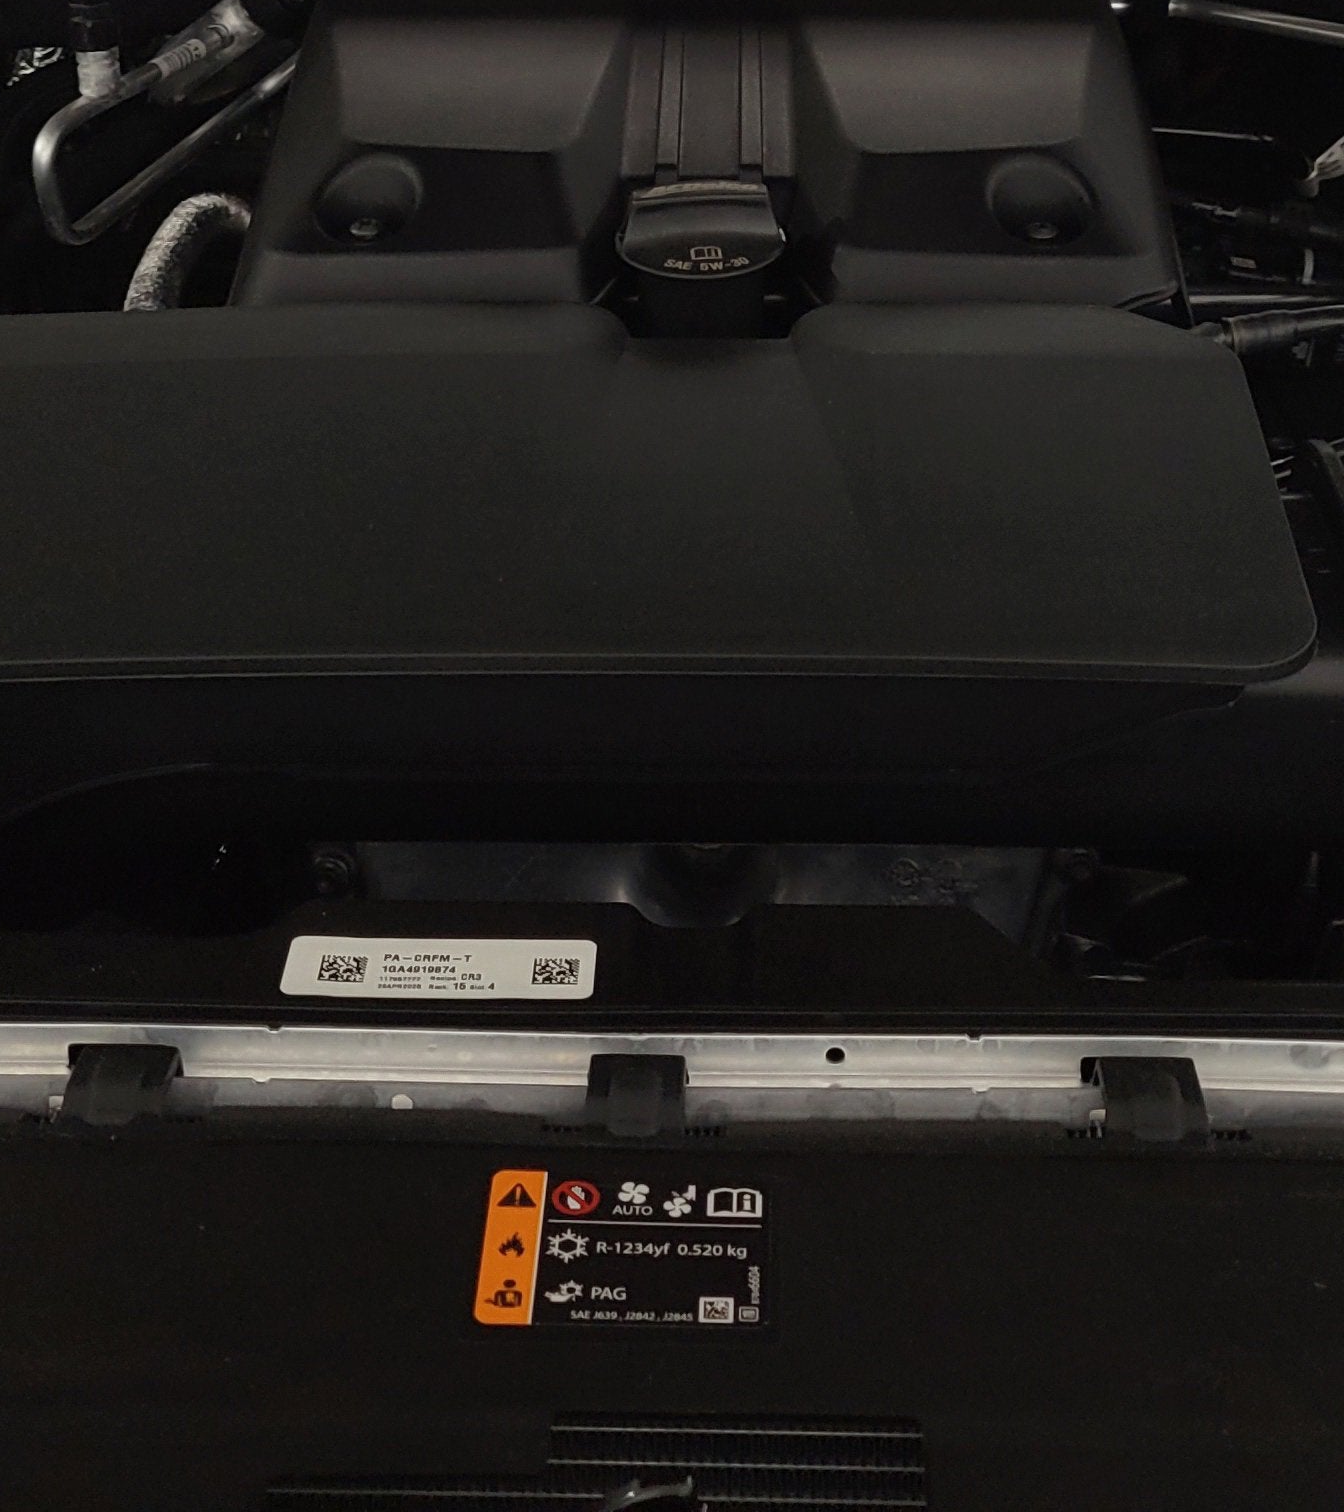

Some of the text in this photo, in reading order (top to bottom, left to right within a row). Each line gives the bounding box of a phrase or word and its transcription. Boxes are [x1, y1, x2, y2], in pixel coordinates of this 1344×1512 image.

[664, 256, 750, 270] SAE 5W-30
[453, 982, 467, 991] 15
[488, 982, 495, 991] 4
[611, 1204, 653, 1216] AUTO
[596, 1240, 748, 1260] R-1234yf 0.520 kg
[590, 1286, 627, 1301] PAG
[570, 1309, 591, 1320] SAE
